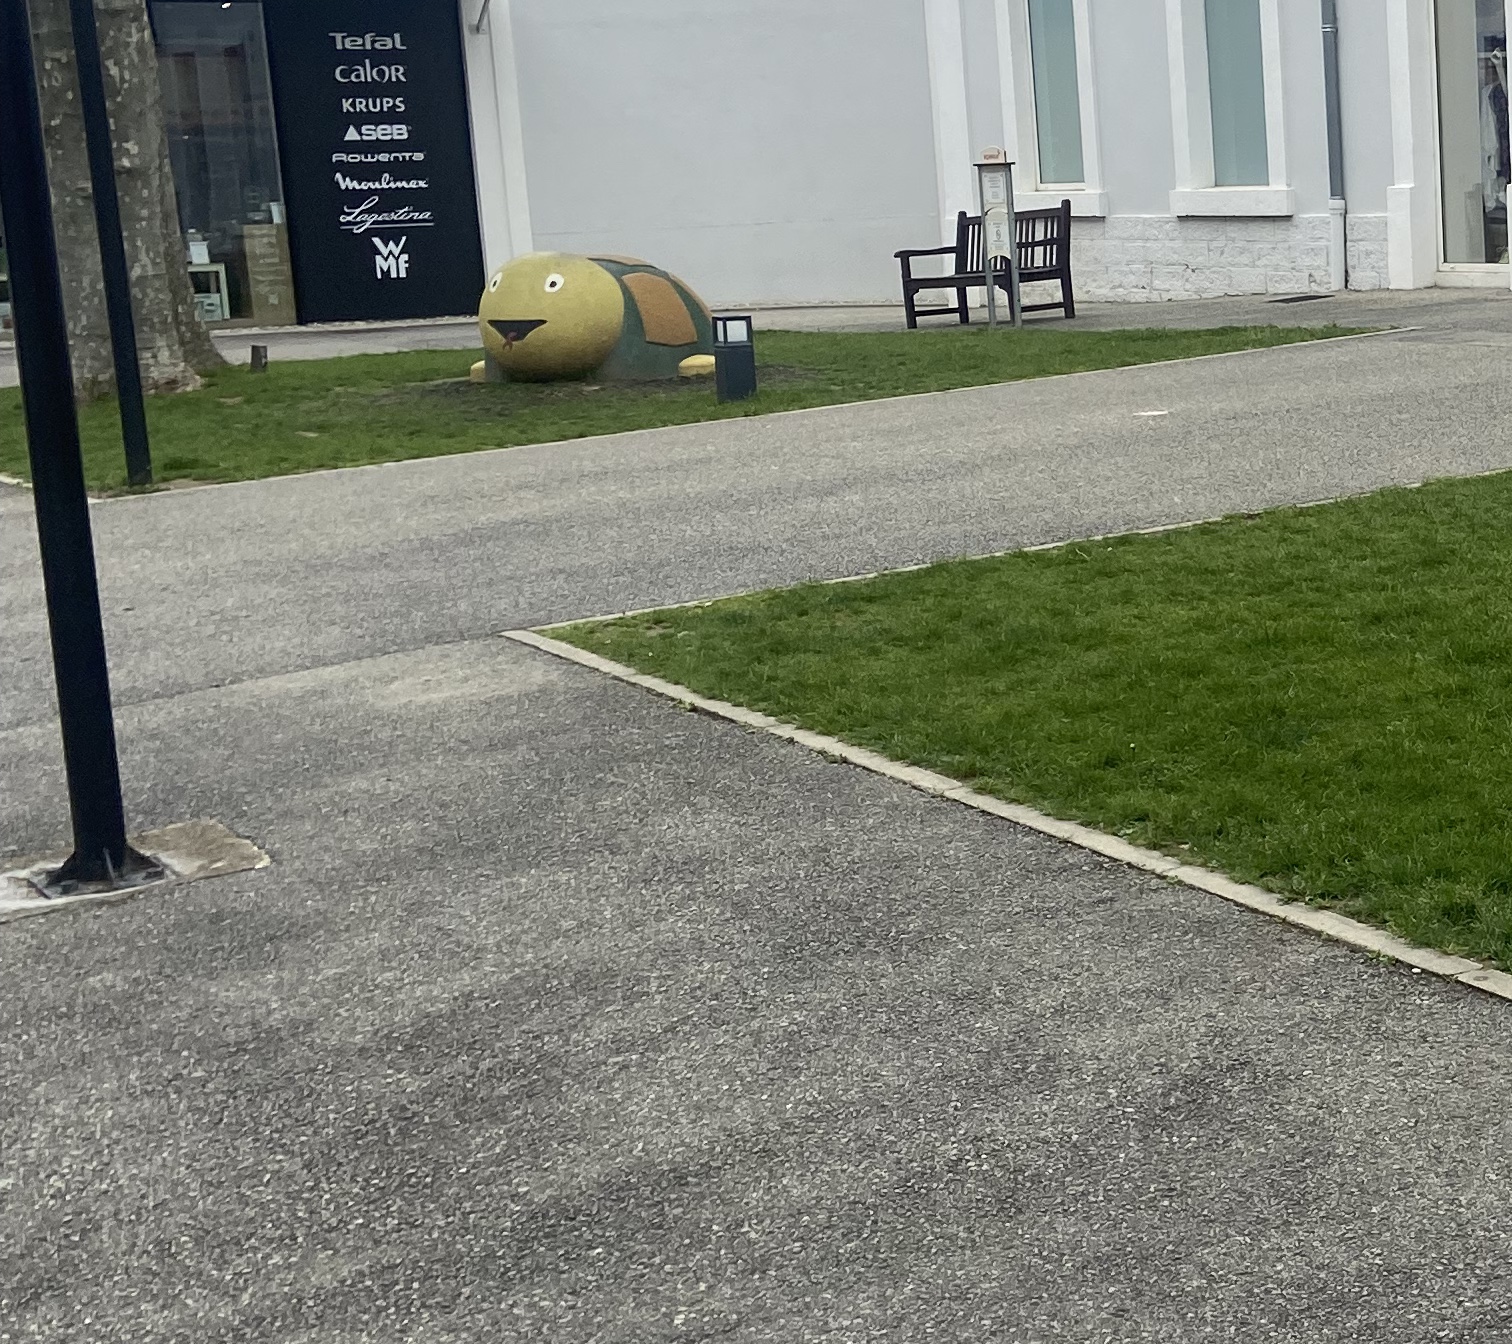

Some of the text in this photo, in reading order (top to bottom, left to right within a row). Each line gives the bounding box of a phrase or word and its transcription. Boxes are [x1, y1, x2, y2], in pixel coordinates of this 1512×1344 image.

[329, 32, 407, 50] Tefal
[341, 97, 406, 113] KRUPS
[334, 172, 429, 191] Moulinex
[339, 196, 433, 233] Lagostina
